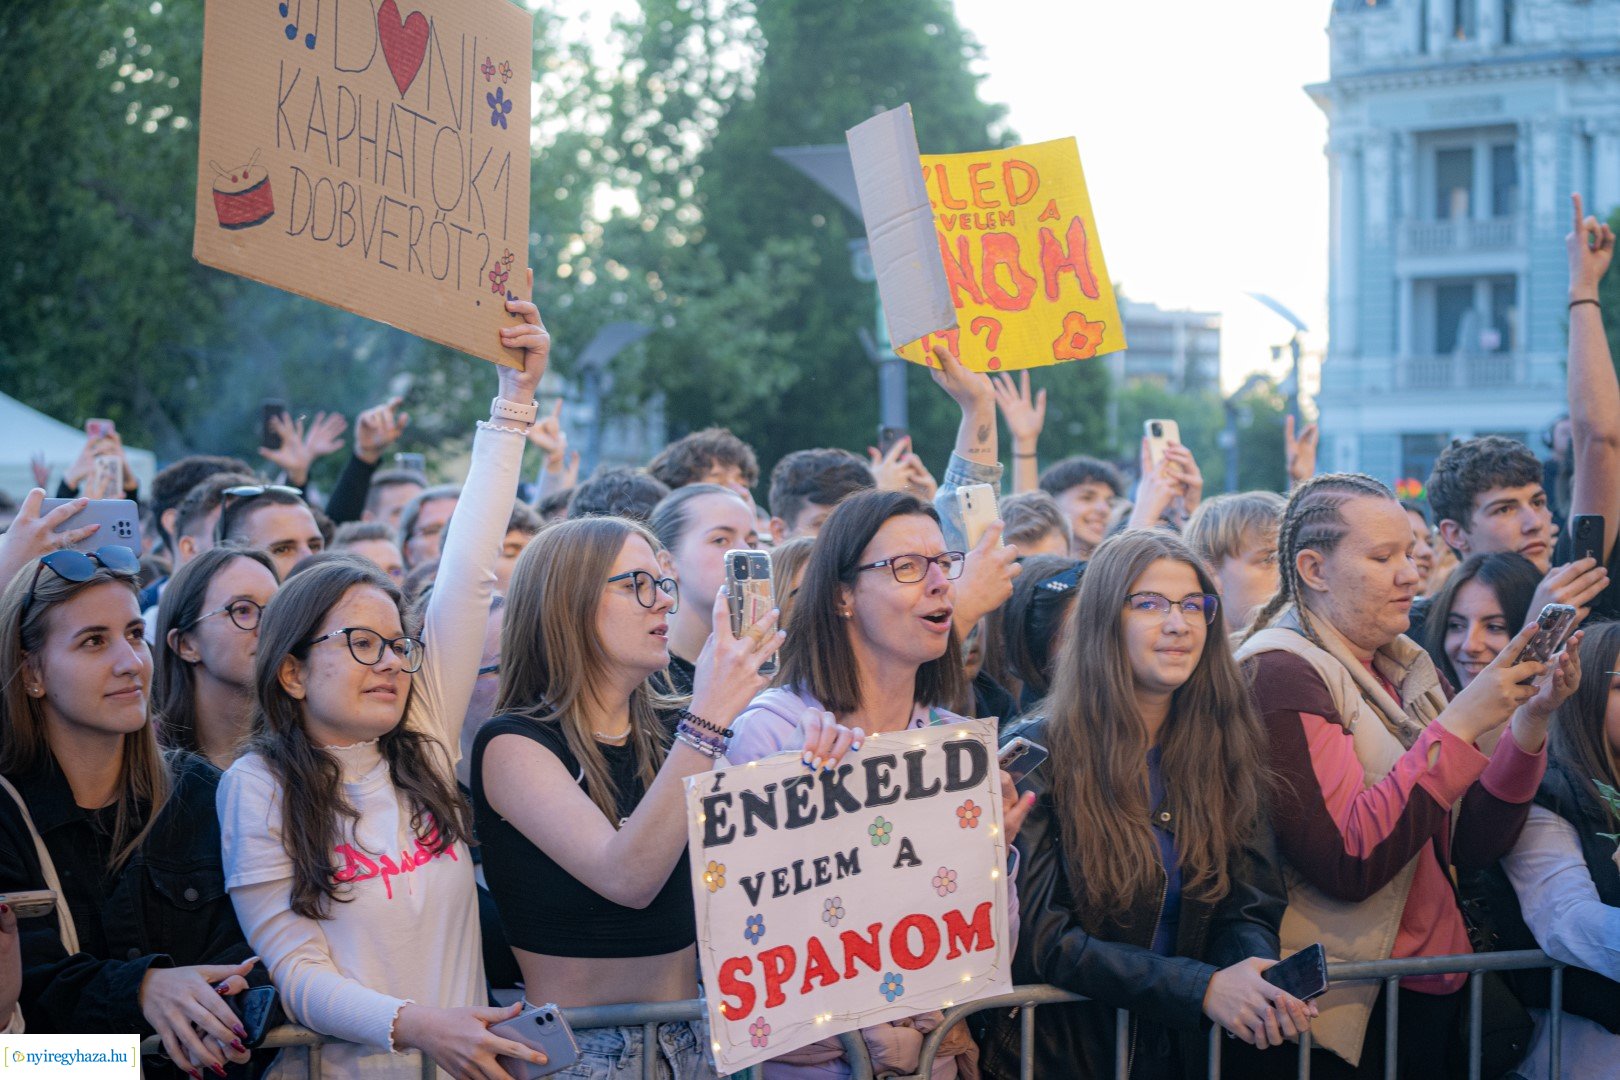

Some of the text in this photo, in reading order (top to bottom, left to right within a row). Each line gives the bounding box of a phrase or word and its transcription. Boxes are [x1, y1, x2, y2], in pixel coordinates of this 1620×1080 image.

[277, 60, 493, 230] KAPHATOK
[940, 209, 1016, 231] VELEM
[700, 738, 989, 848] ÉNEKELD
[739, 836, 922, 907] VELEM A
[717, 901, 995, 1022] SPANOM
